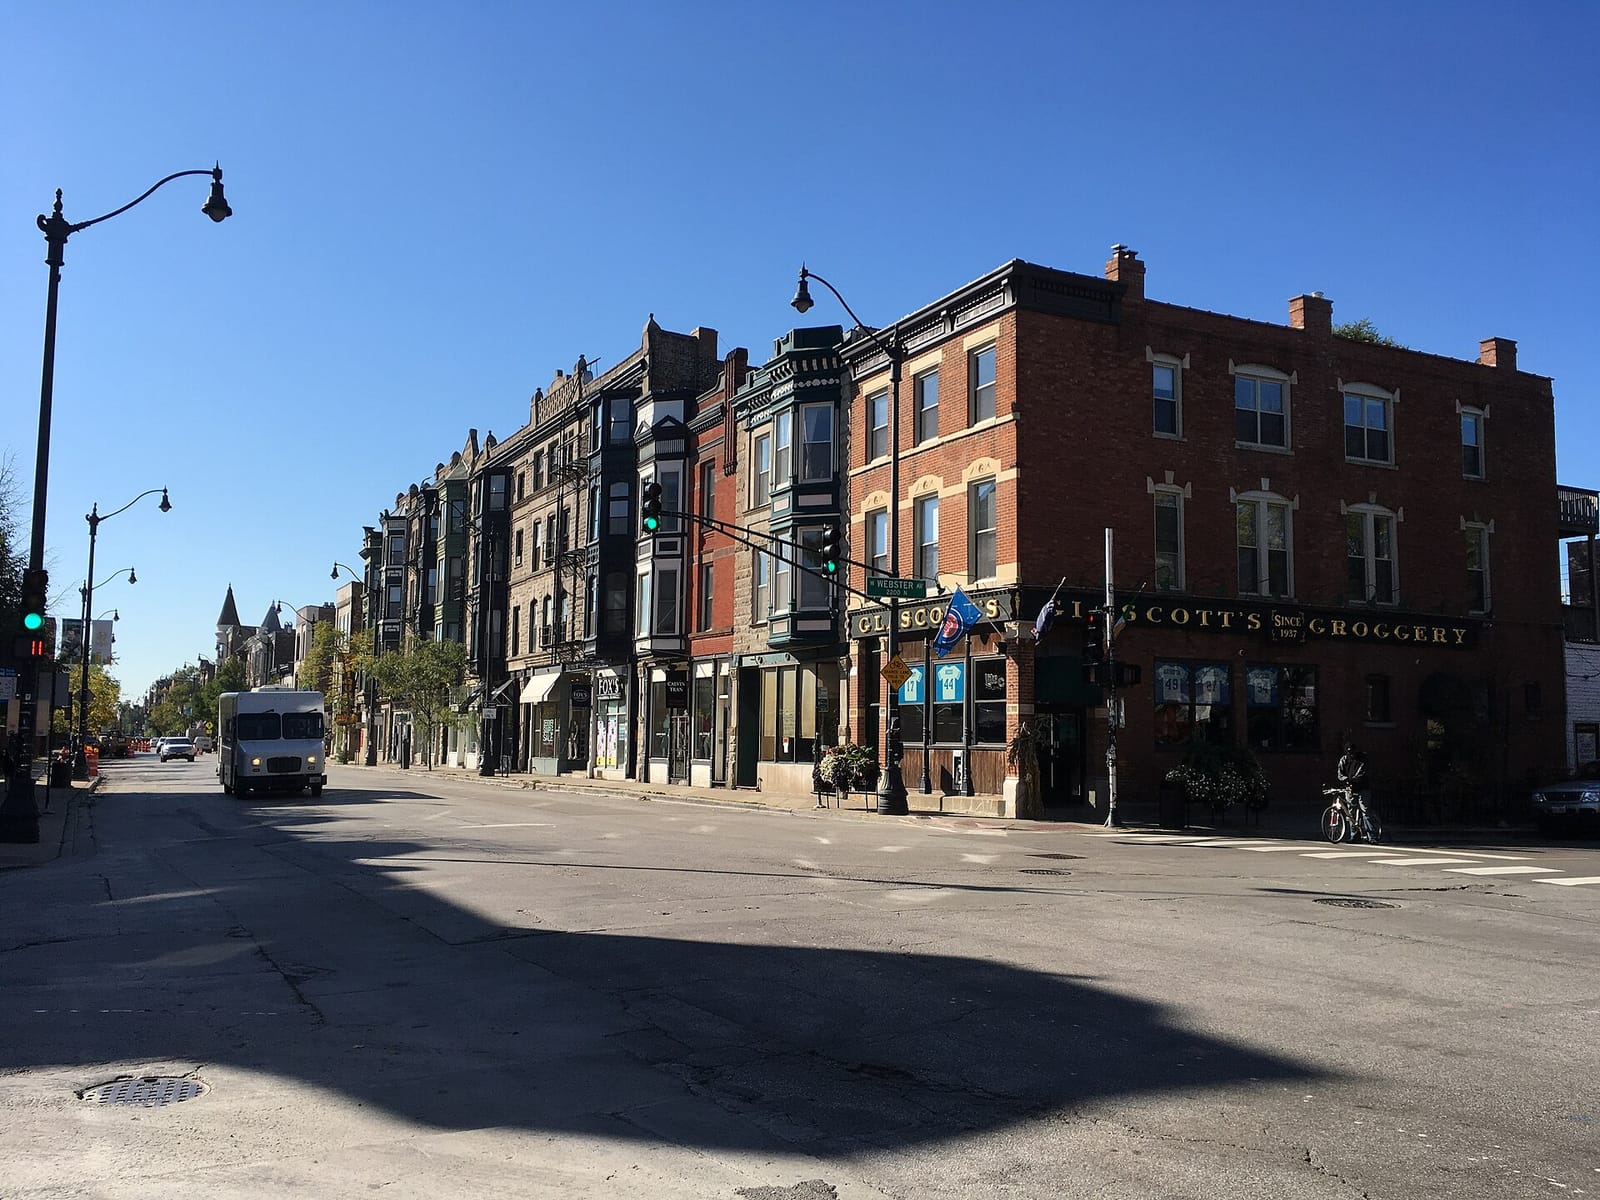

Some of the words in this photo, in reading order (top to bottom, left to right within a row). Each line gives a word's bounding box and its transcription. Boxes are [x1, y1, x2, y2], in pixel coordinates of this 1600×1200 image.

[877, 579, 913, 590] WEBSTER
[1274, 614, 1301, 627] SINCE
[1280, 628, 1297, 638] 1937
[1309, 618, 1467, 644] GROGGERY
[31, 640, 43, 656] 11
[598, 678, 620, 695] FOX'S
[907, 680, 914, 692] 17
[944, 678, 954, 690] 44
[1165, 678, 1178, 690] 49
